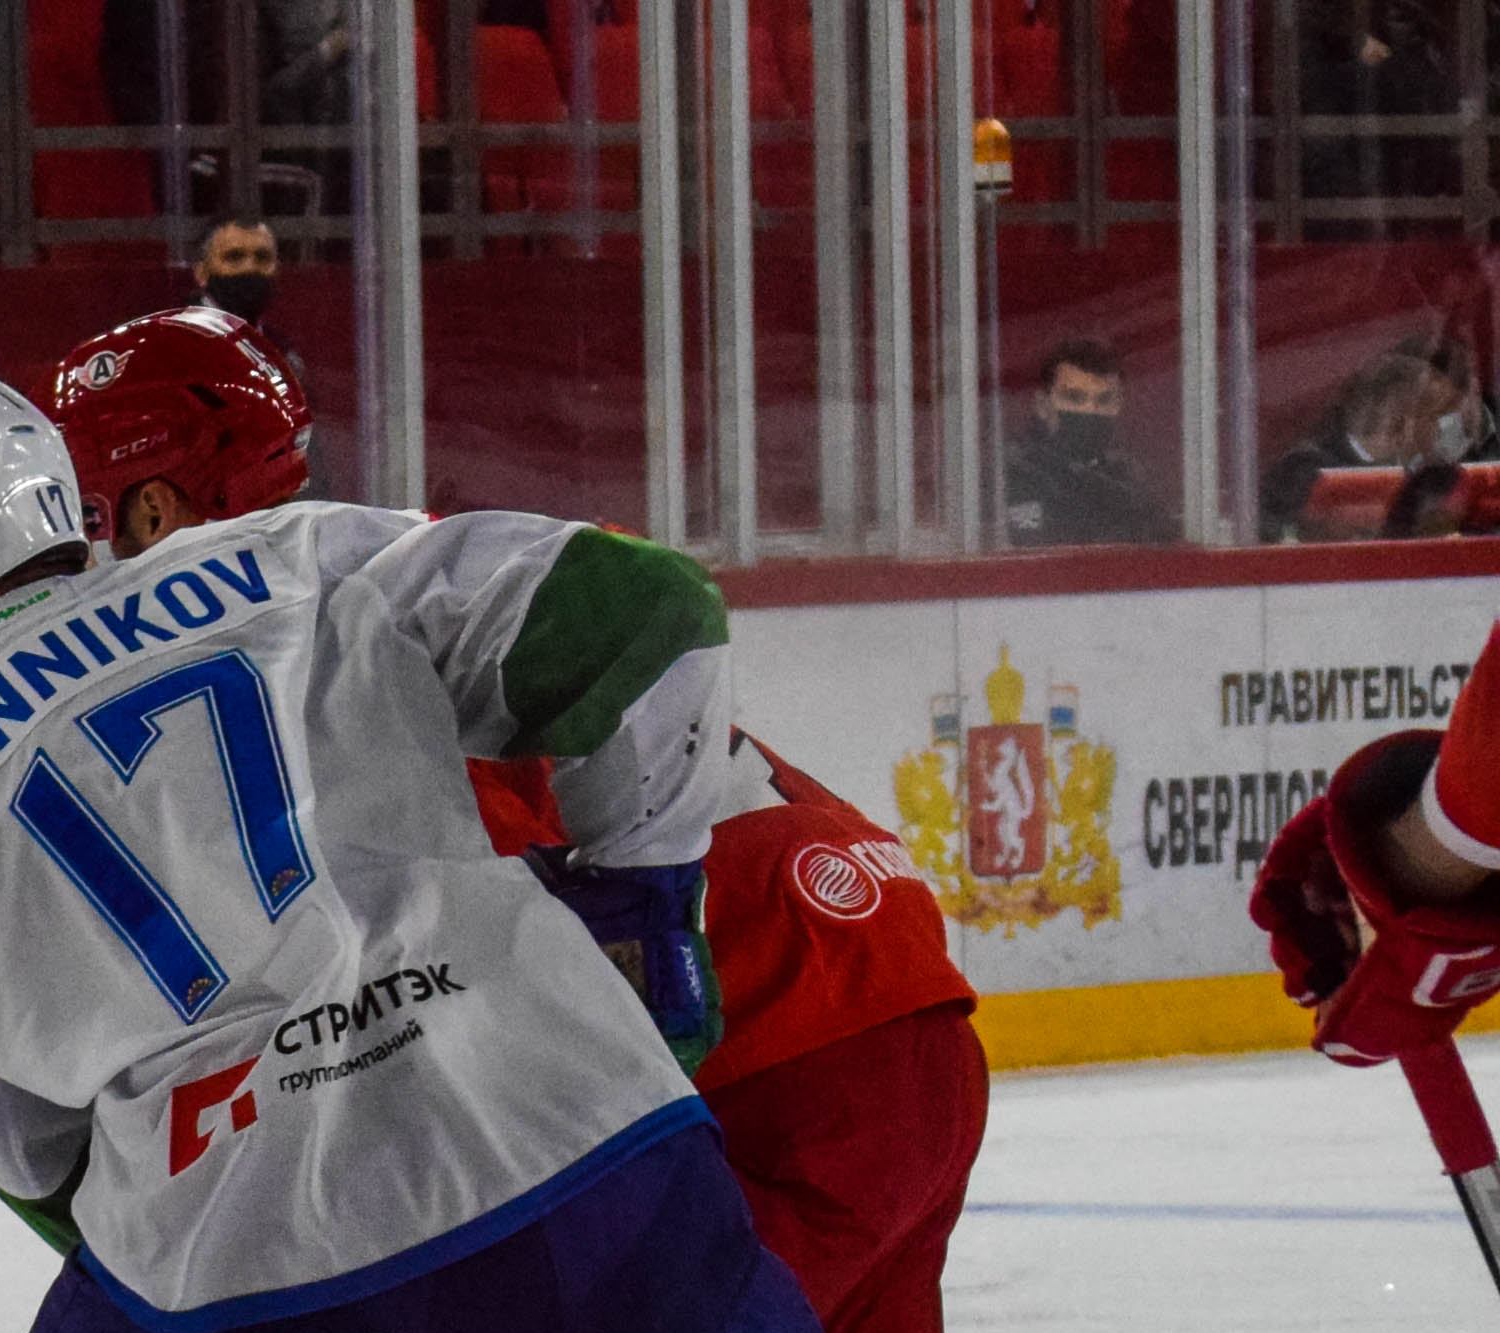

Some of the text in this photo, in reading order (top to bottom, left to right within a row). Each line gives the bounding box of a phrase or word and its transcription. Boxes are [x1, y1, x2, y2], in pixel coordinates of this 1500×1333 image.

[110, 429, 169, 461] CCM
[34, 484, 75, 533] 17
[10, 646, 317, 1027] 17
